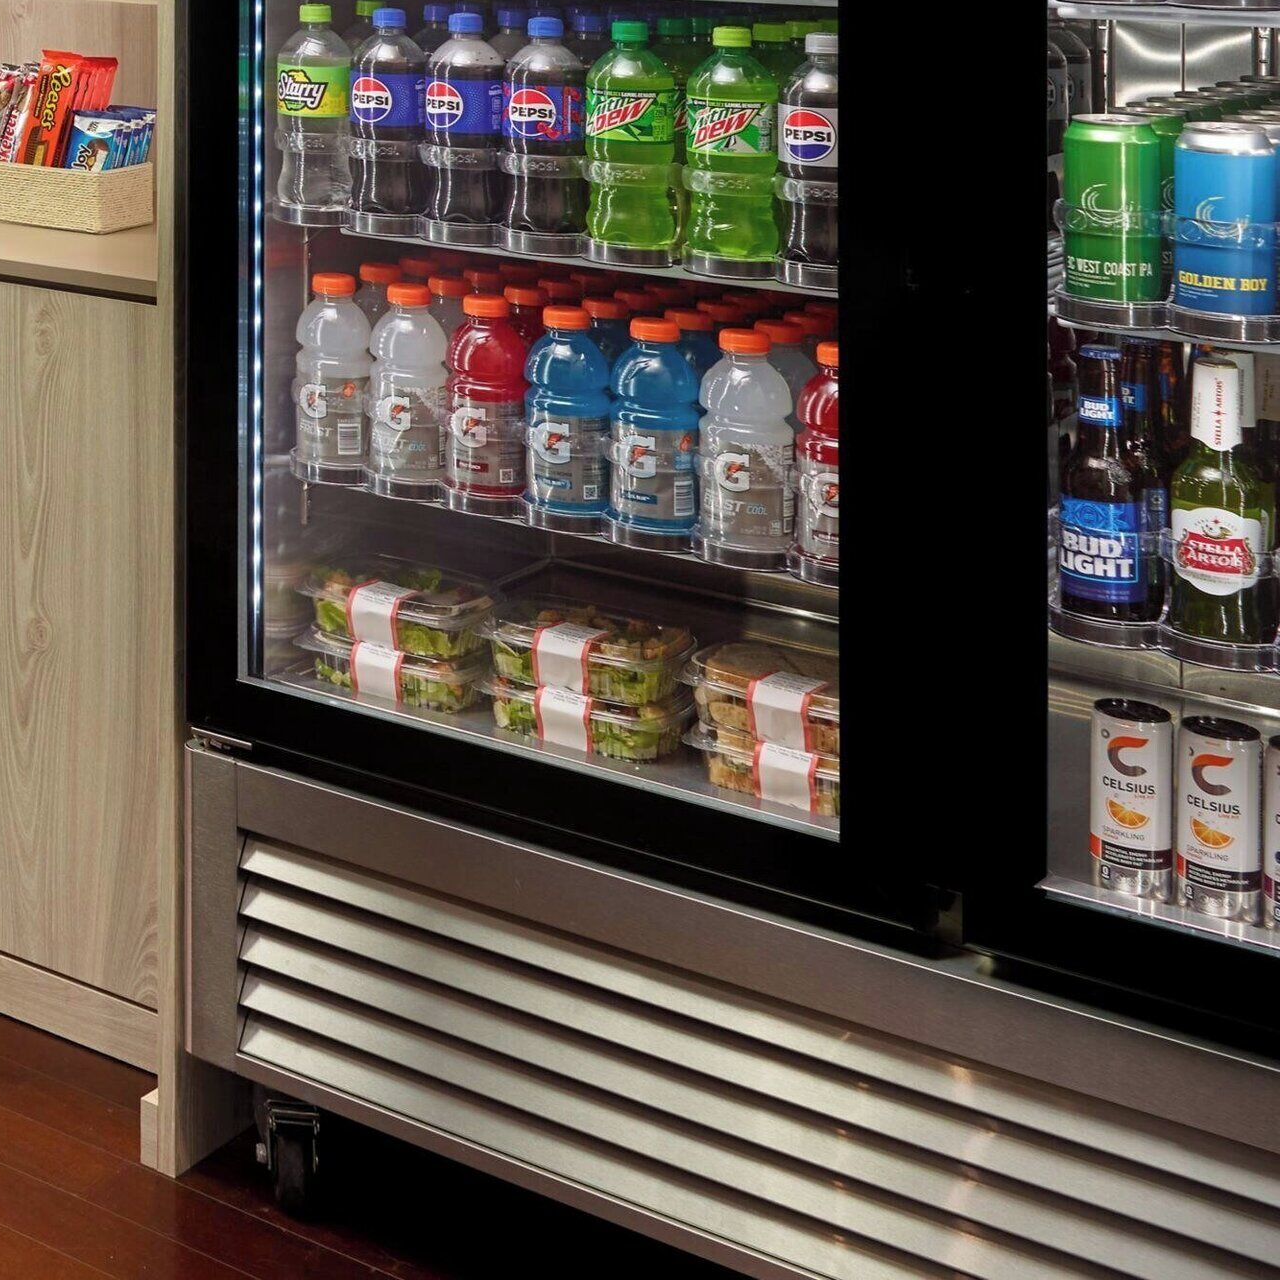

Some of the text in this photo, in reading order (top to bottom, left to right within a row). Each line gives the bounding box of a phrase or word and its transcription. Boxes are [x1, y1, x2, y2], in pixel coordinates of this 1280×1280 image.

[41, 65, 73, 131] Reese's
[278, 70, 325, 109] Starry
[353, 93, 389, 106] PEPSI
[426, 99, 460, 111] PEPSI
[511, 106, 553, 119] PEPSI
[785, 128, 831, 143] PEPSI
[71, 144, 92, 170] Joy
[1077, 258, 1102, 274] WEST
[1104, 261, 1137, 276] COAST
[1139, 263, 1153, 276] IPA
[1178, 270, 1268, 292] GOLDEN BOY
[1080, 408, 1114, 420] LIGHT
[1083, 401, 1109, 412] BUD
[1062, 530, 1122, 557] BUD
[1190, 538, 1242, 556] STELLA
[1060, 550, 1134, 578] LIGHT
[1187, 549, 1244, 568] ARTOIS
[1102, 776, 1155, 795] CELSIUS
[1187, 794, 1241, 816] CELSIUS
[1102, 825, 1145, 841] SPARKLING
[1186, 844, 1229, 862] SPARKLING
